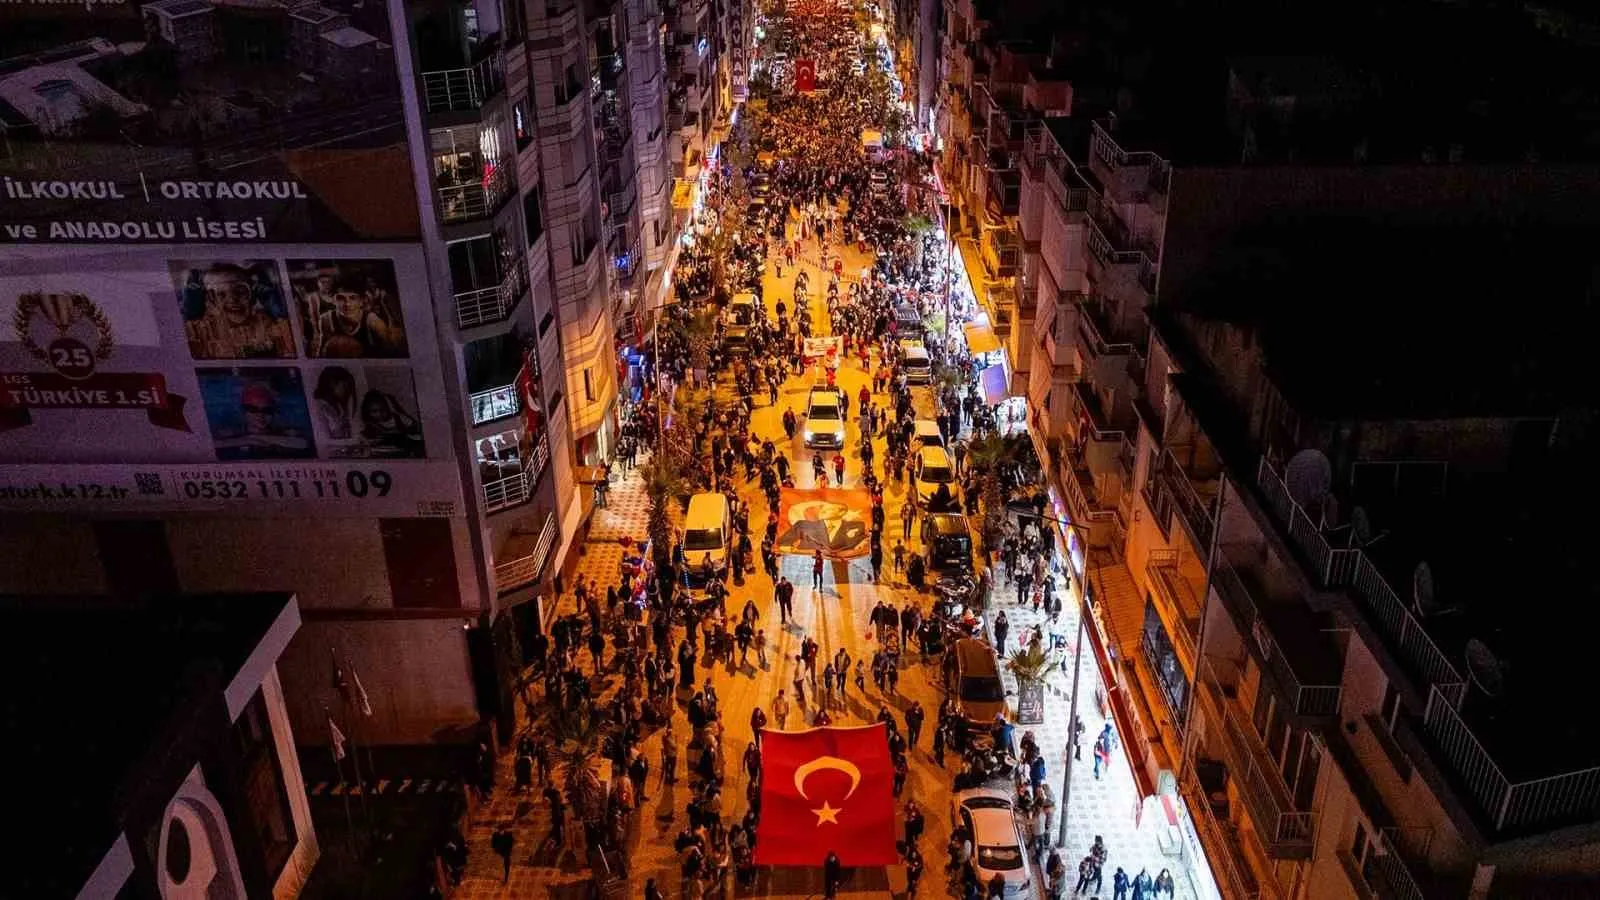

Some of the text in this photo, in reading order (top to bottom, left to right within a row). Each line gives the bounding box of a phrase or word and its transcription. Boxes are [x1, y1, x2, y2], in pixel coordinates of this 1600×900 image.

[4, 176, 308, 199] İLKOKUL ORTAOKUL
[5, 217, 267, 239] ve ANADOLU LİSESİ
[52, 349, 91, 367] 25
[8, 386, 111, 405] TÜRKİYE
[180, 471, 264, 480] KURUMSAL
[184, 470, 392, 499] 0532 111 11 09
